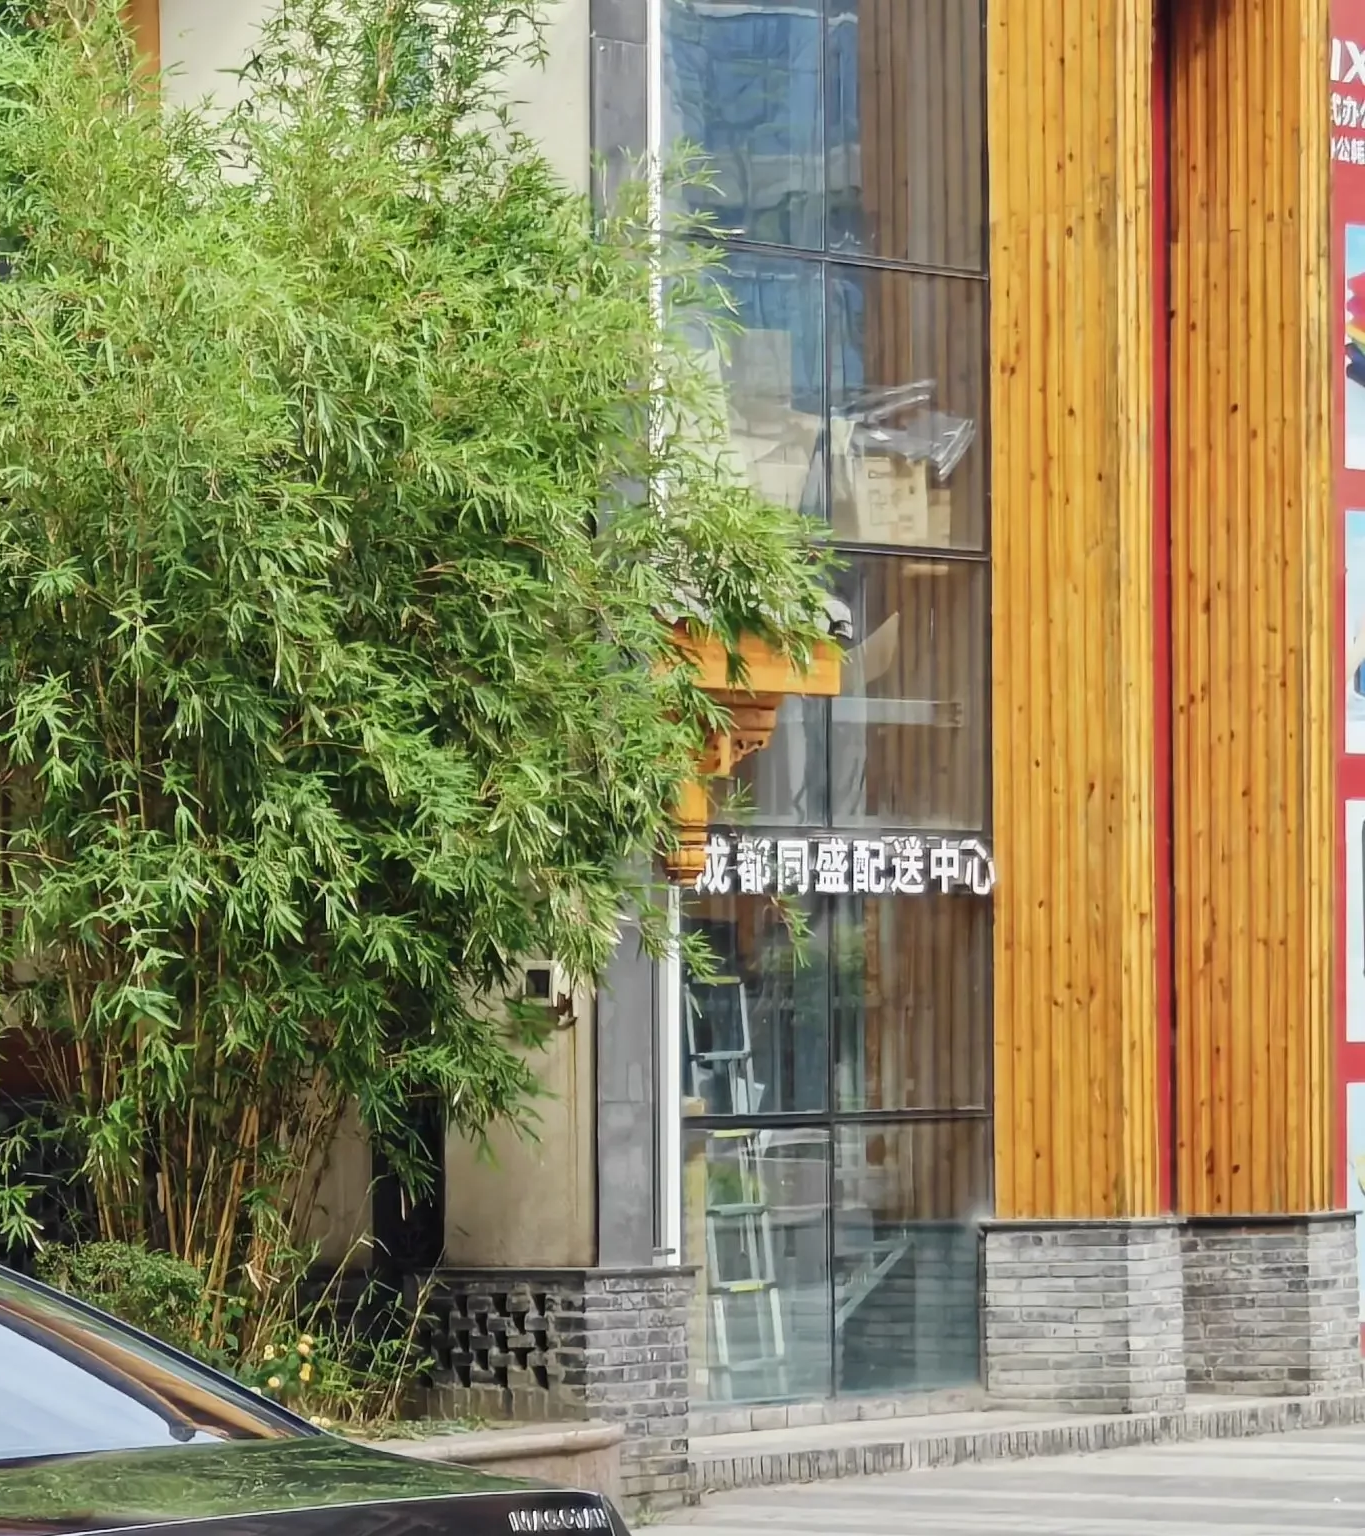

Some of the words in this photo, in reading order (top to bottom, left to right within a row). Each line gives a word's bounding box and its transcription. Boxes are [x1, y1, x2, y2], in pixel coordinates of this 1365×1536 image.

[693, 836, 996, 896] 成都同盛配送中心
